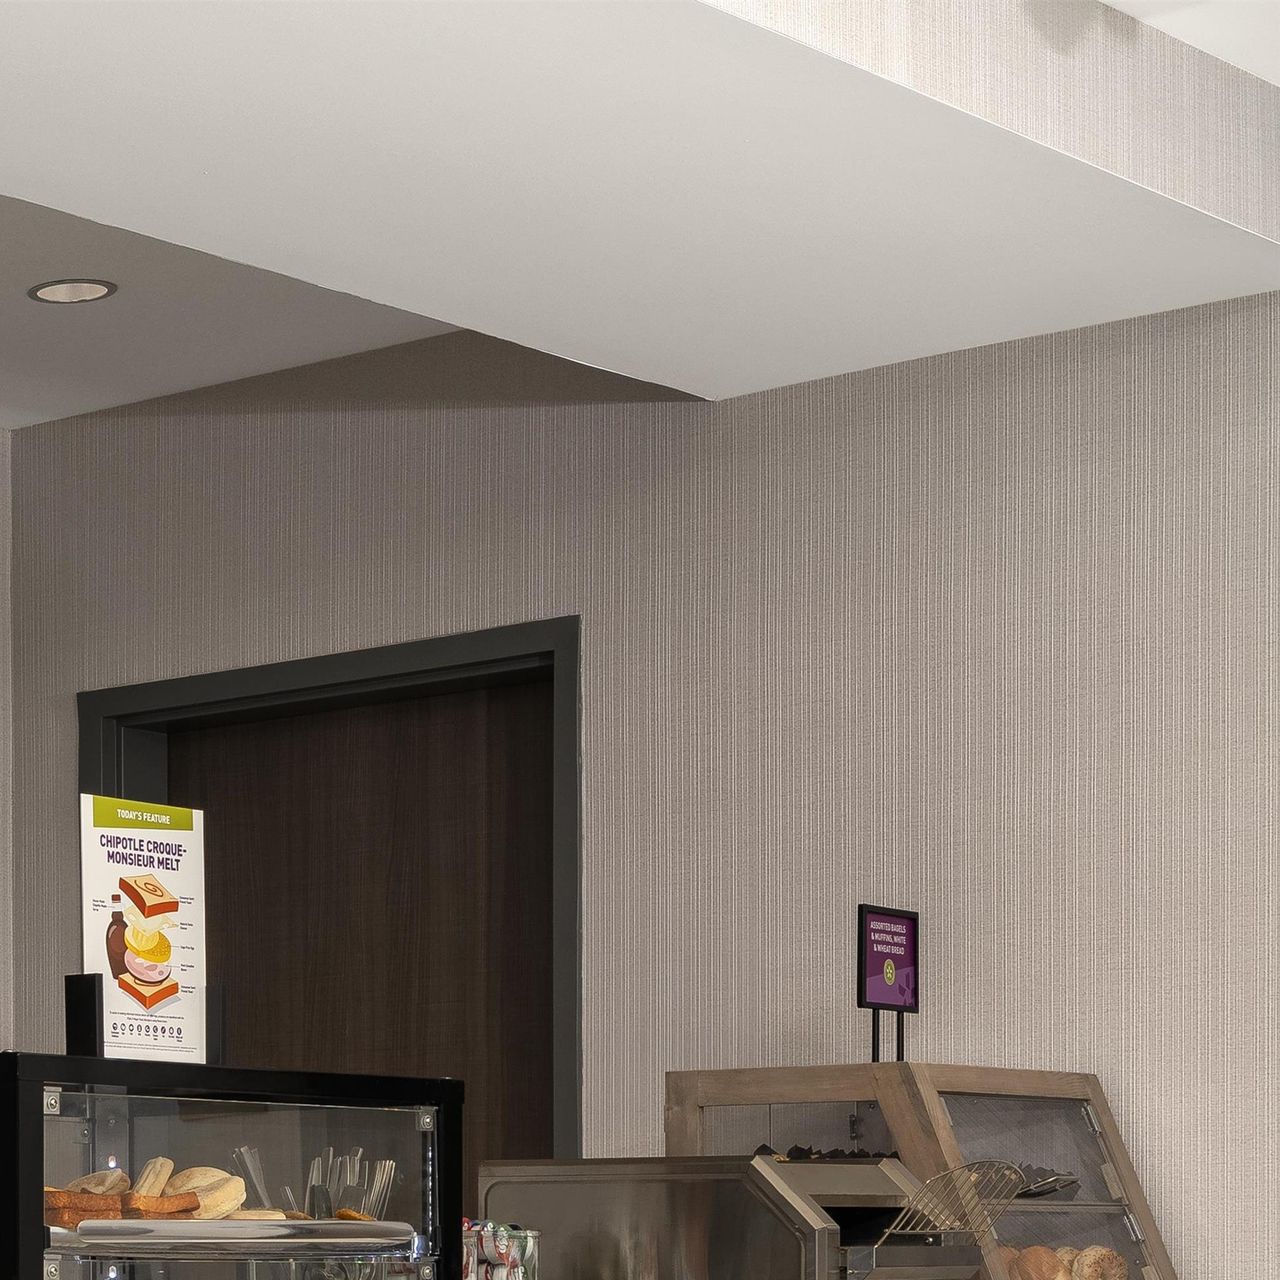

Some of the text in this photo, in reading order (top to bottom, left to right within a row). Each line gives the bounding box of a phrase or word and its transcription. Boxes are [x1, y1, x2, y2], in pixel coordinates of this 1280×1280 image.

[117, 809, 170, 824] TODAY'S FEATURE
[100, 834, 187, 857] CHIPOTLE CROQUE-
[107, 850, 180, 871] MONSIEUR MELT
